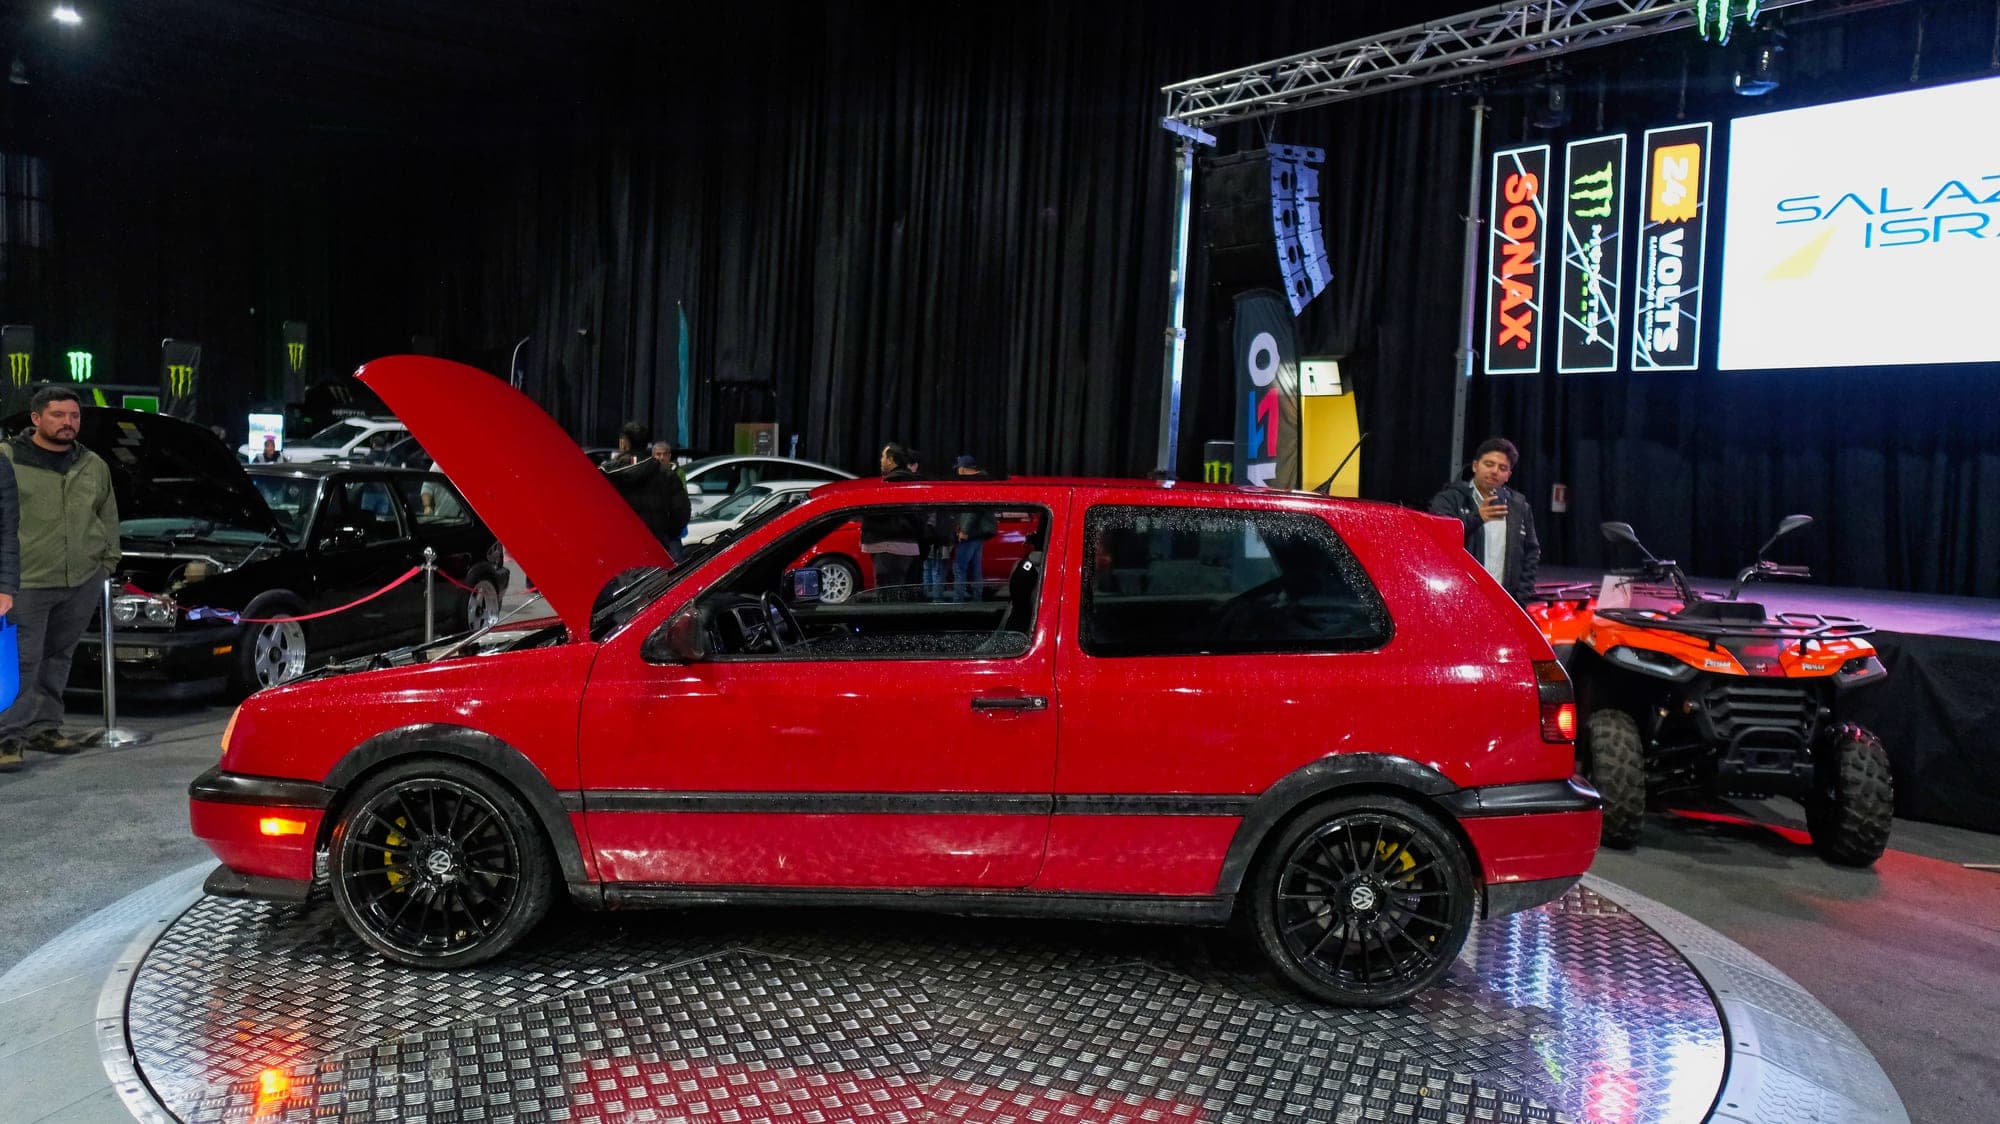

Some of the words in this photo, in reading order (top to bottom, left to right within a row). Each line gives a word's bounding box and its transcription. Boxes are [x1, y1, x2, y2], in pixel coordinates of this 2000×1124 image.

[1661, 156, 1688, 207] 24
[1499, 172, 1538, 347] SONAX
[1865, 212, 2000, 248] ISR
[1653, 228, 1684, 352] VOLTS
